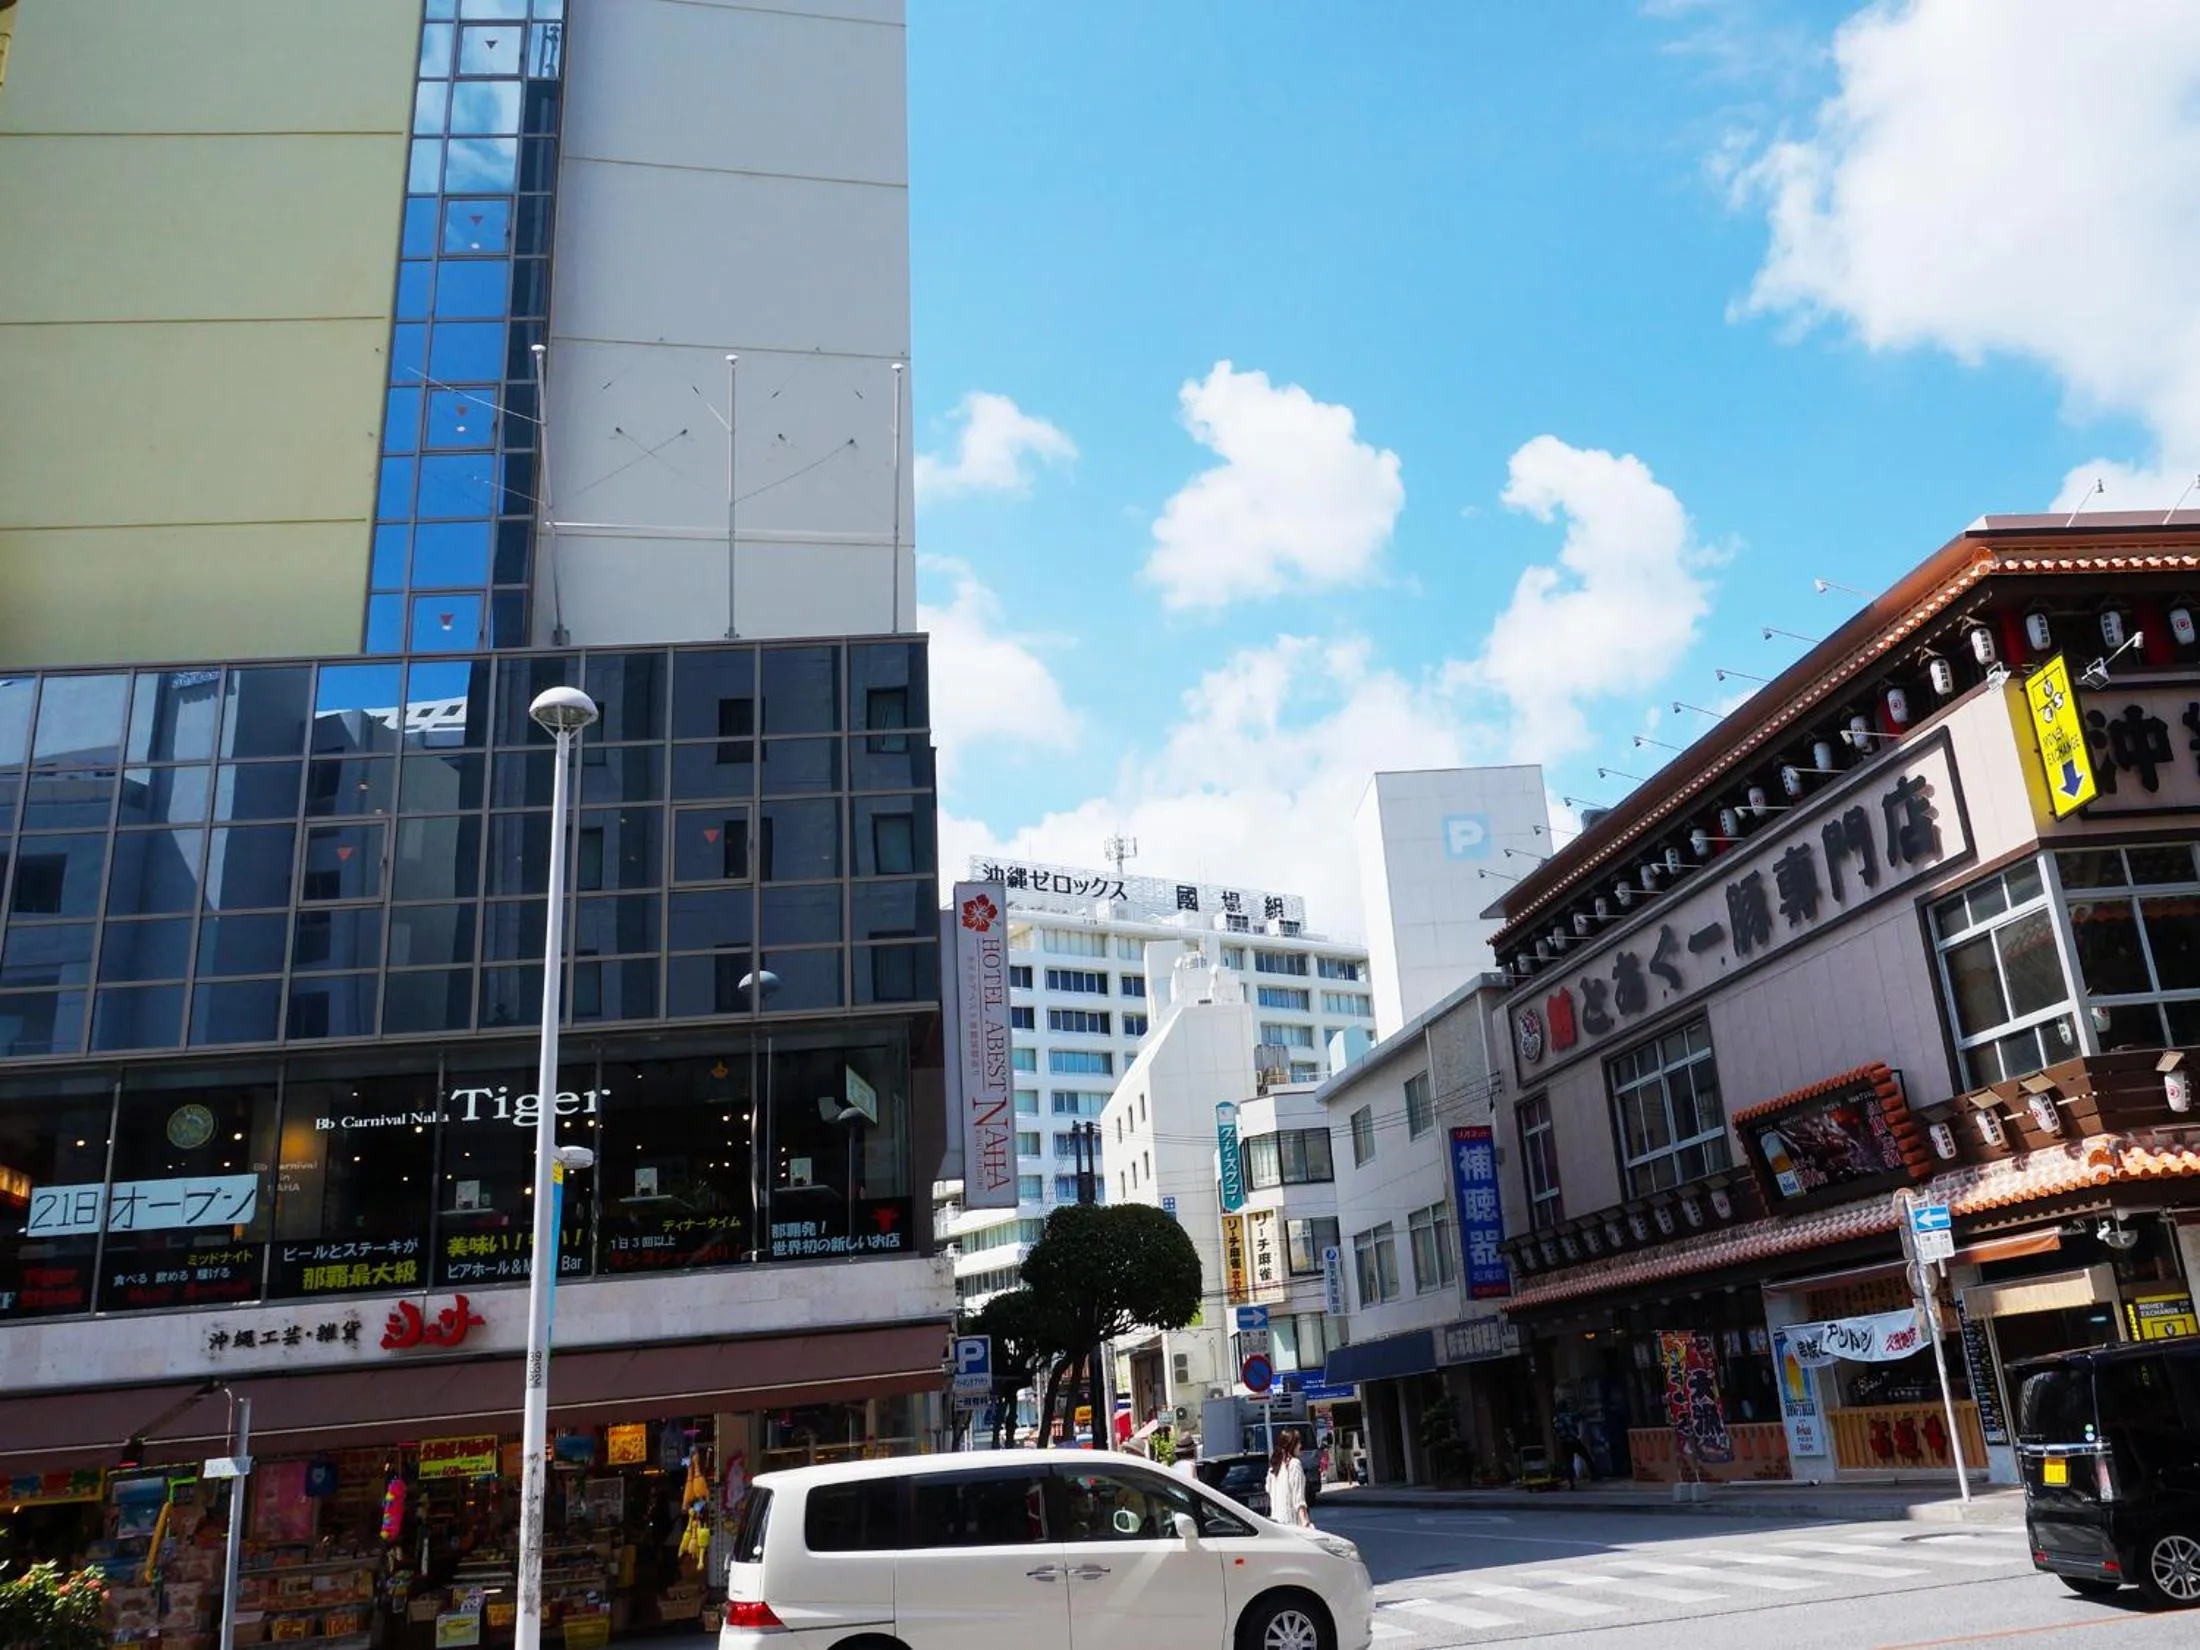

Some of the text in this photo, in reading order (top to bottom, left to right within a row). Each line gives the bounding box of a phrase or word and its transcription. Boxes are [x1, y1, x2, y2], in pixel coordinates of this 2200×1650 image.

[2086, 702, 2200, 796] 沖
[1448, 820, 1484, 854] P
[981, 863, 1128, 901] 沖縄ゼロックス
[972, 938, 1011, 1192] HOTEL ABEST NAHA
[315, 1117, 335, 1130] Bb
[341, 1113, 406, 1128] Carnival
[450, 1086, 611, 1127] Tiger
[278, 1160, 317, 1171] arnival
[268, 1182, 300, 1192] AHA
[30, 1186, 256, 1230] 21日オープン
[662, 1216, 742, 1233] ディナータイム
[188, 1249, 253, 1267] ミッドナイト
[284, 1238, 419, 1262] ビールとステーキが
[772, 1232, 901, 1257] 世界初の新しいお店
[302, 1260, 417, 1290] 那覇最大級
[561, 1255, 582, 1271] Bar
[209, 1320, 363, 1351] 沖縄工芸・雑貨
[958, 1339, 984, 1373] P
